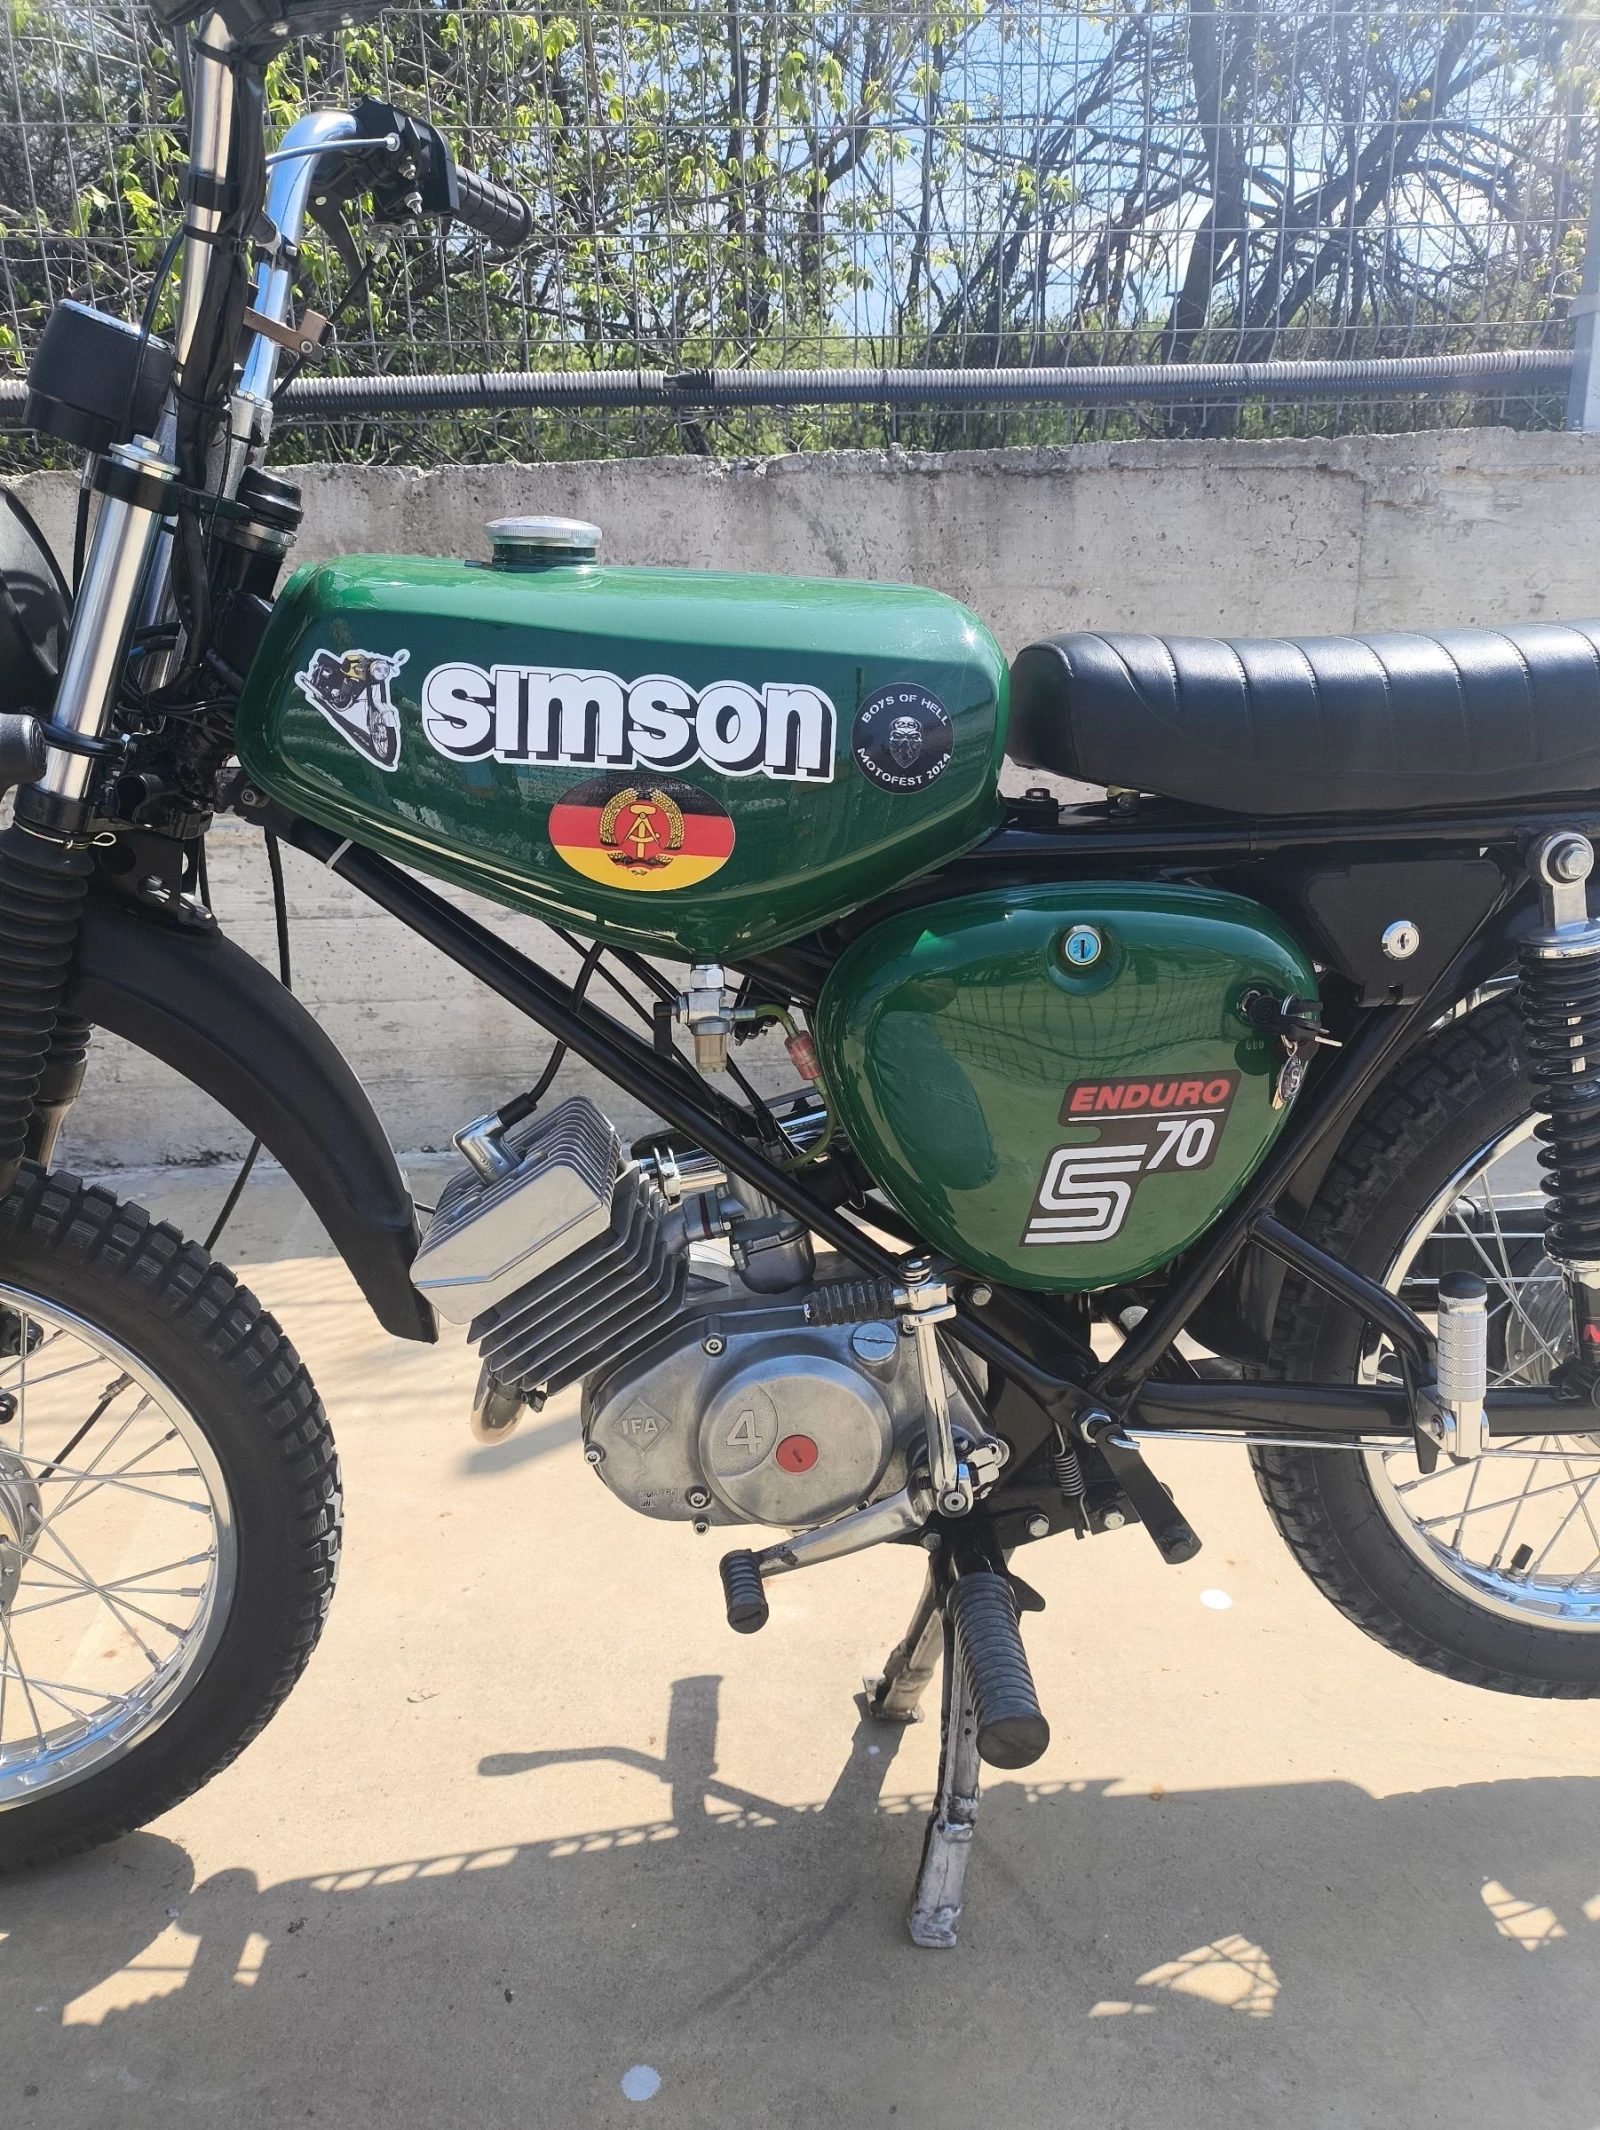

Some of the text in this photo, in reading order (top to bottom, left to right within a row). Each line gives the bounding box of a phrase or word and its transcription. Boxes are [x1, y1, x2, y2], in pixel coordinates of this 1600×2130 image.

[861, 693, 948, 727] BOYS OF HELL
[857, 747, 952, 786] MOTOFEST 2024
[1069, 1079, 1231, 1112] ENDURO
[1145, 1118, 1216, 1170] 70
[621, 1417, 660, 1435] IFA
[726, 1410, 764, 1454] 4
